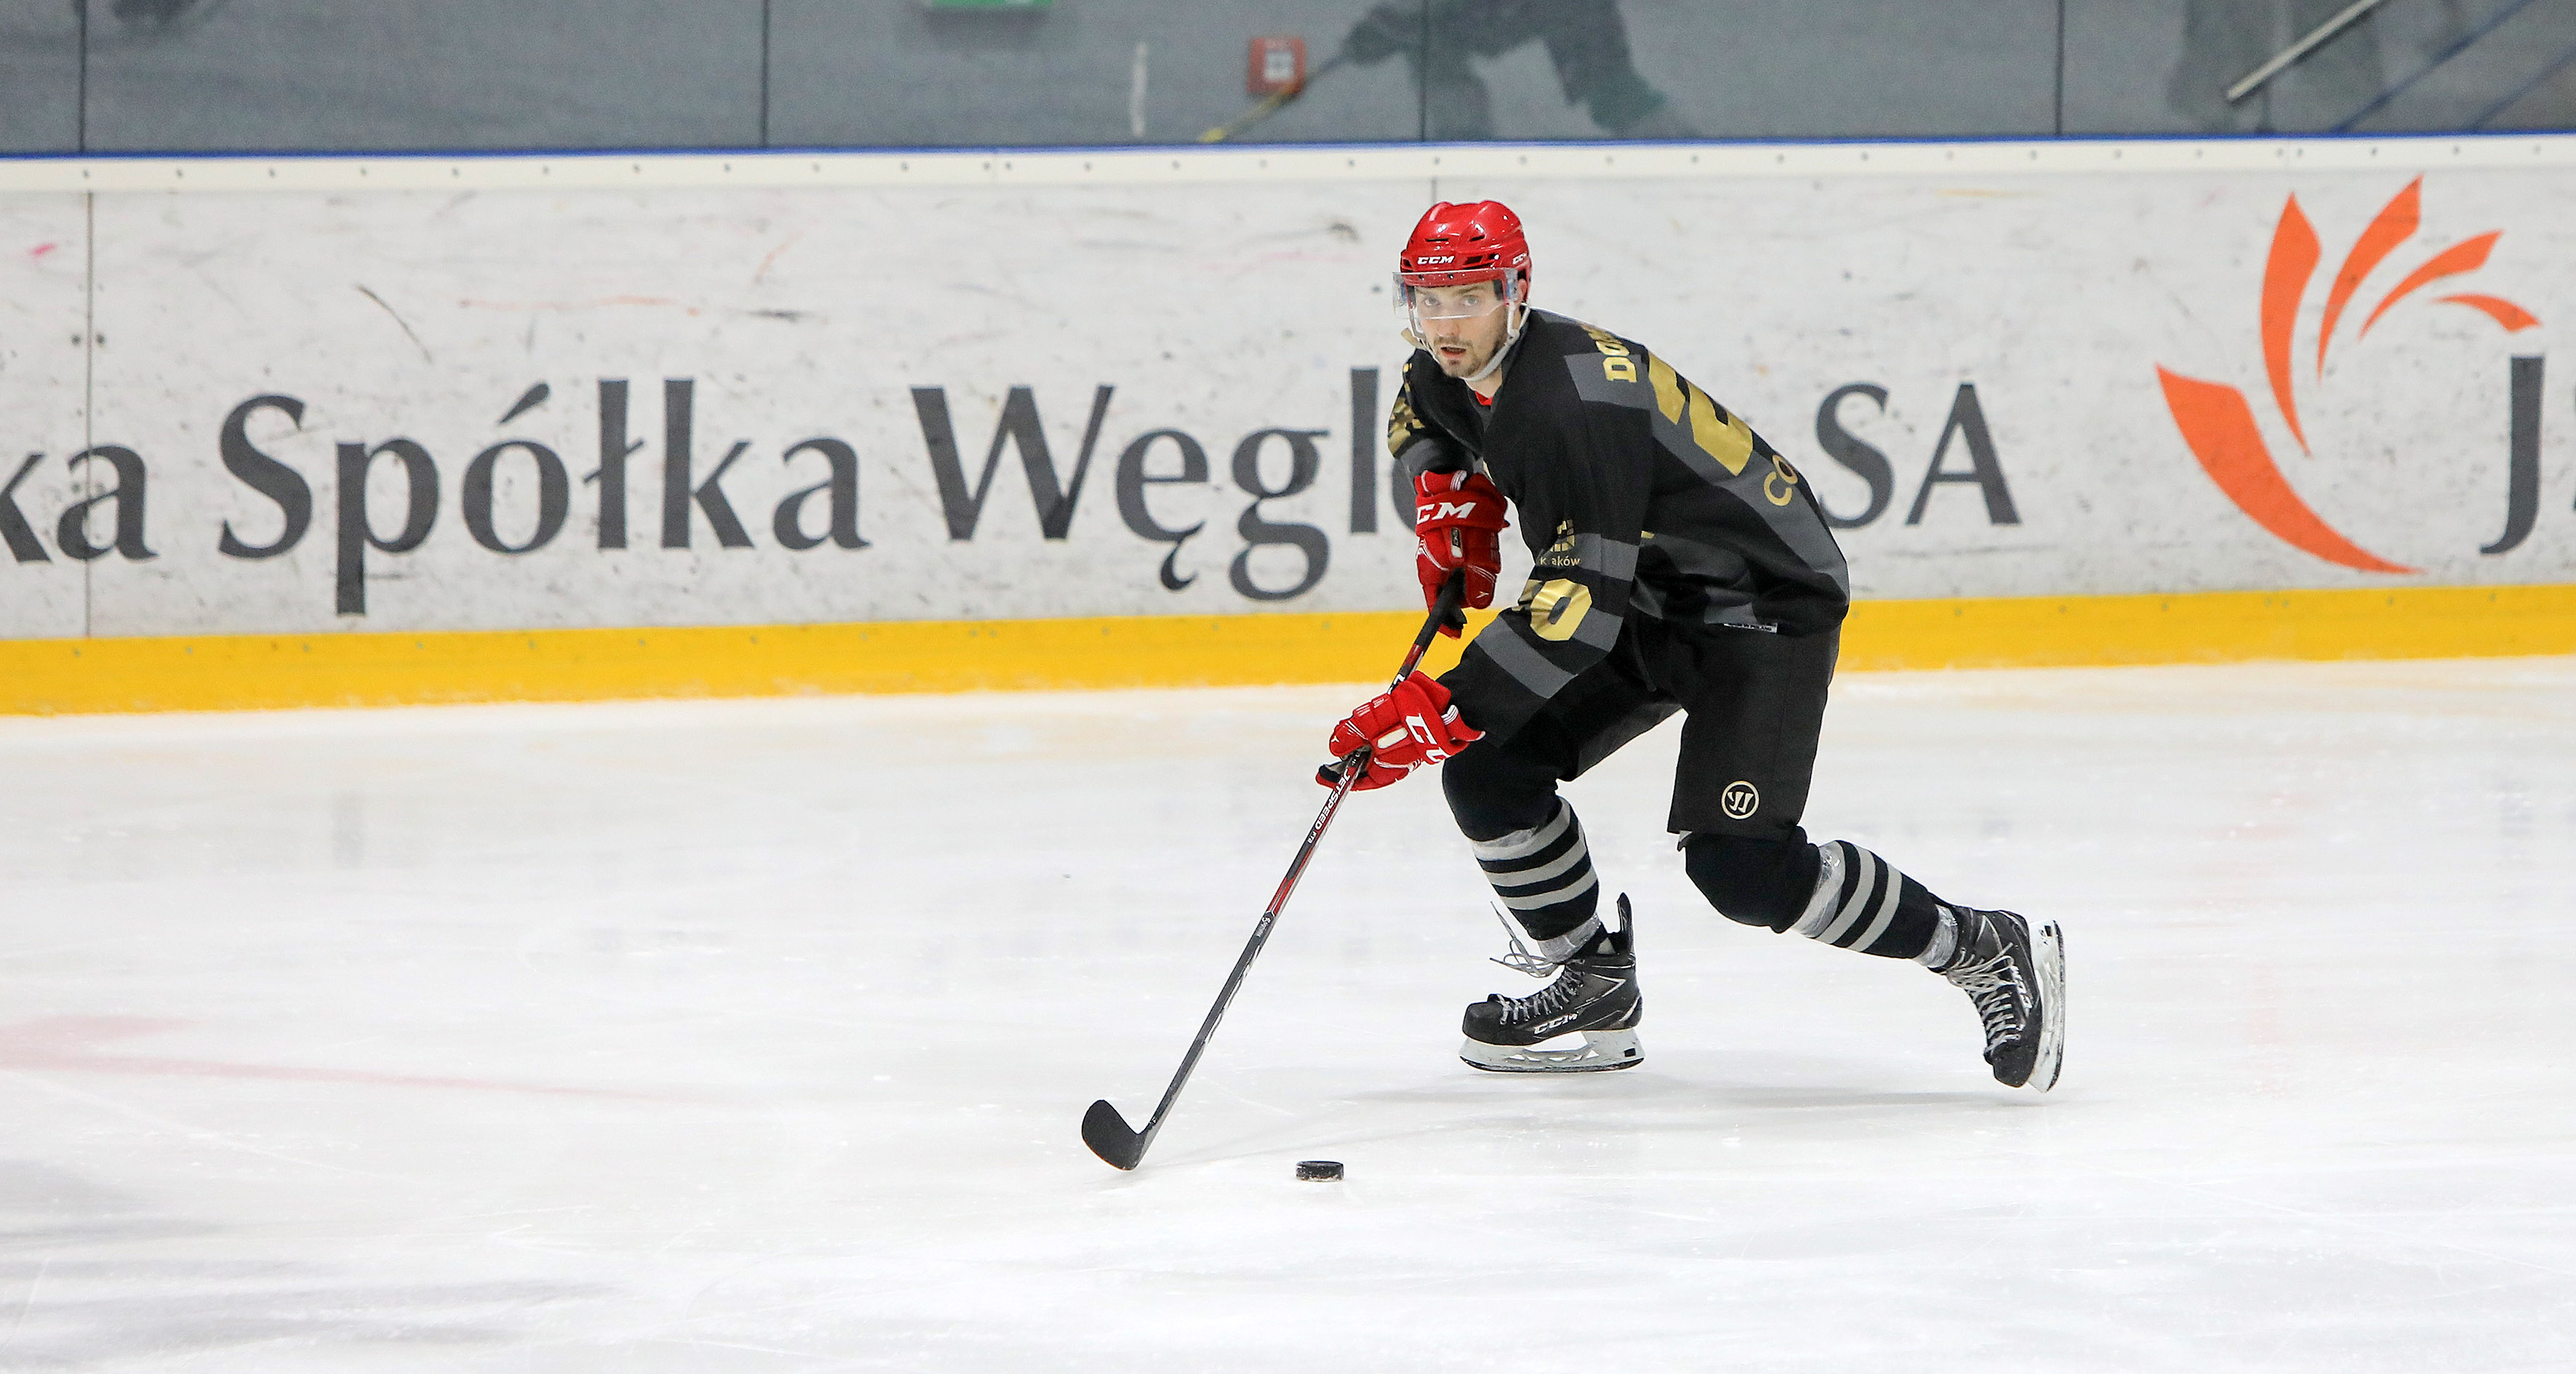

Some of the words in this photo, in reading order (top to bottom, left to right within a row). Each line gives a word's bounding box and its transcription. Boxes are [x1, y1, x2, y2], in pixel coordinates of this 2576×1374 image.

[1417, 255, 1455, 265] CCM
[217, 378, 872, 617] Spółka
[1815, 381, 2021, 529] SA
[1315, 768, 1351, 830] JETSPEED
[1533, 1013, 1578, 1034] CCM
